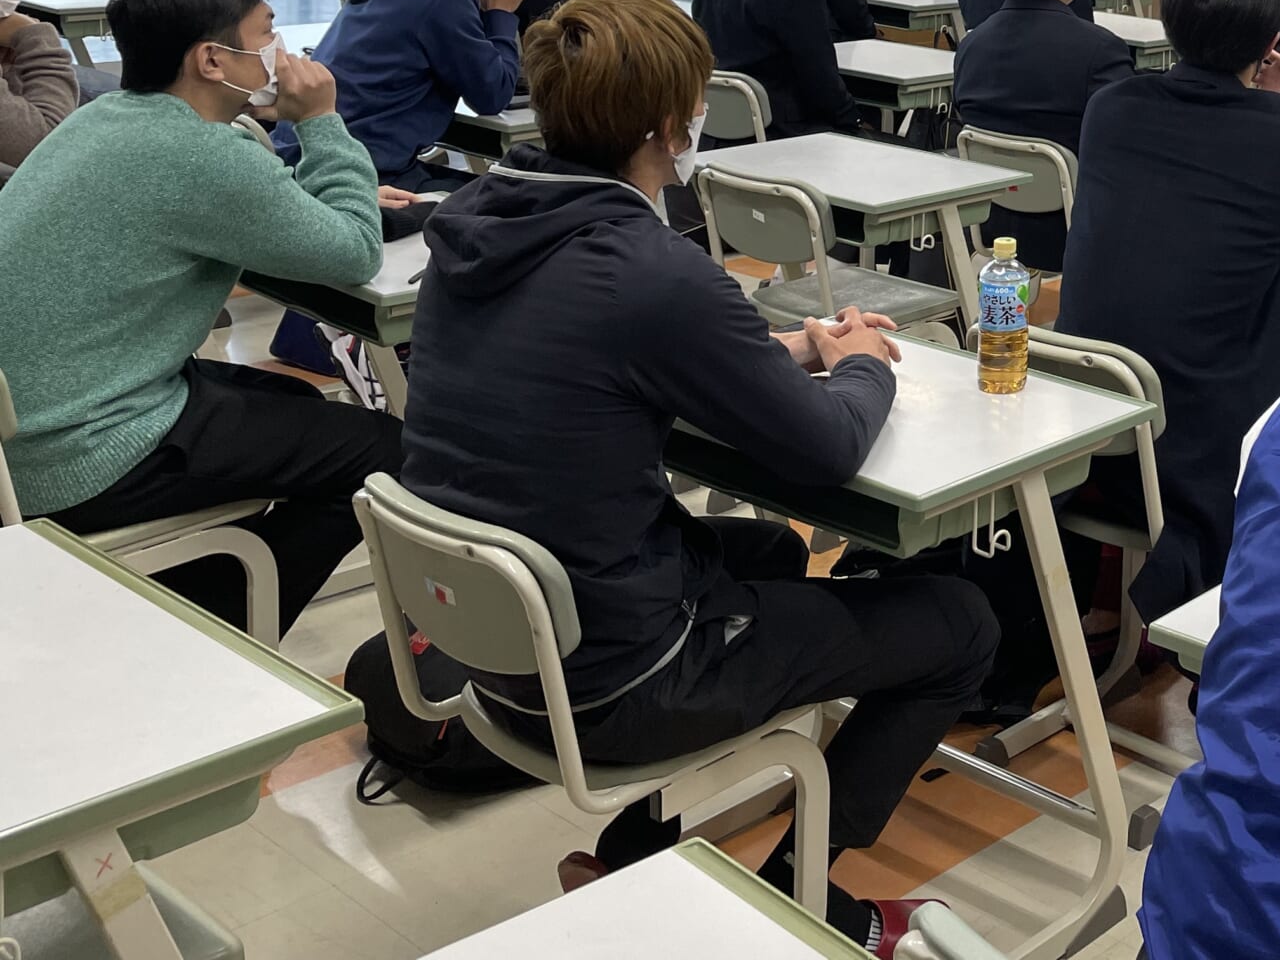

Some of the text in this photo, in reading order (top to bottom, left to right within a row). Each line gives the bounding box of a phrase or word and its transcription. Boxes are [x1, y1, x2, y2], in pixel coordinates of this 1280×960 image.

[983, 294, 1017, 305] やさしい
[983, 304, 1017, 326] 麦茶
